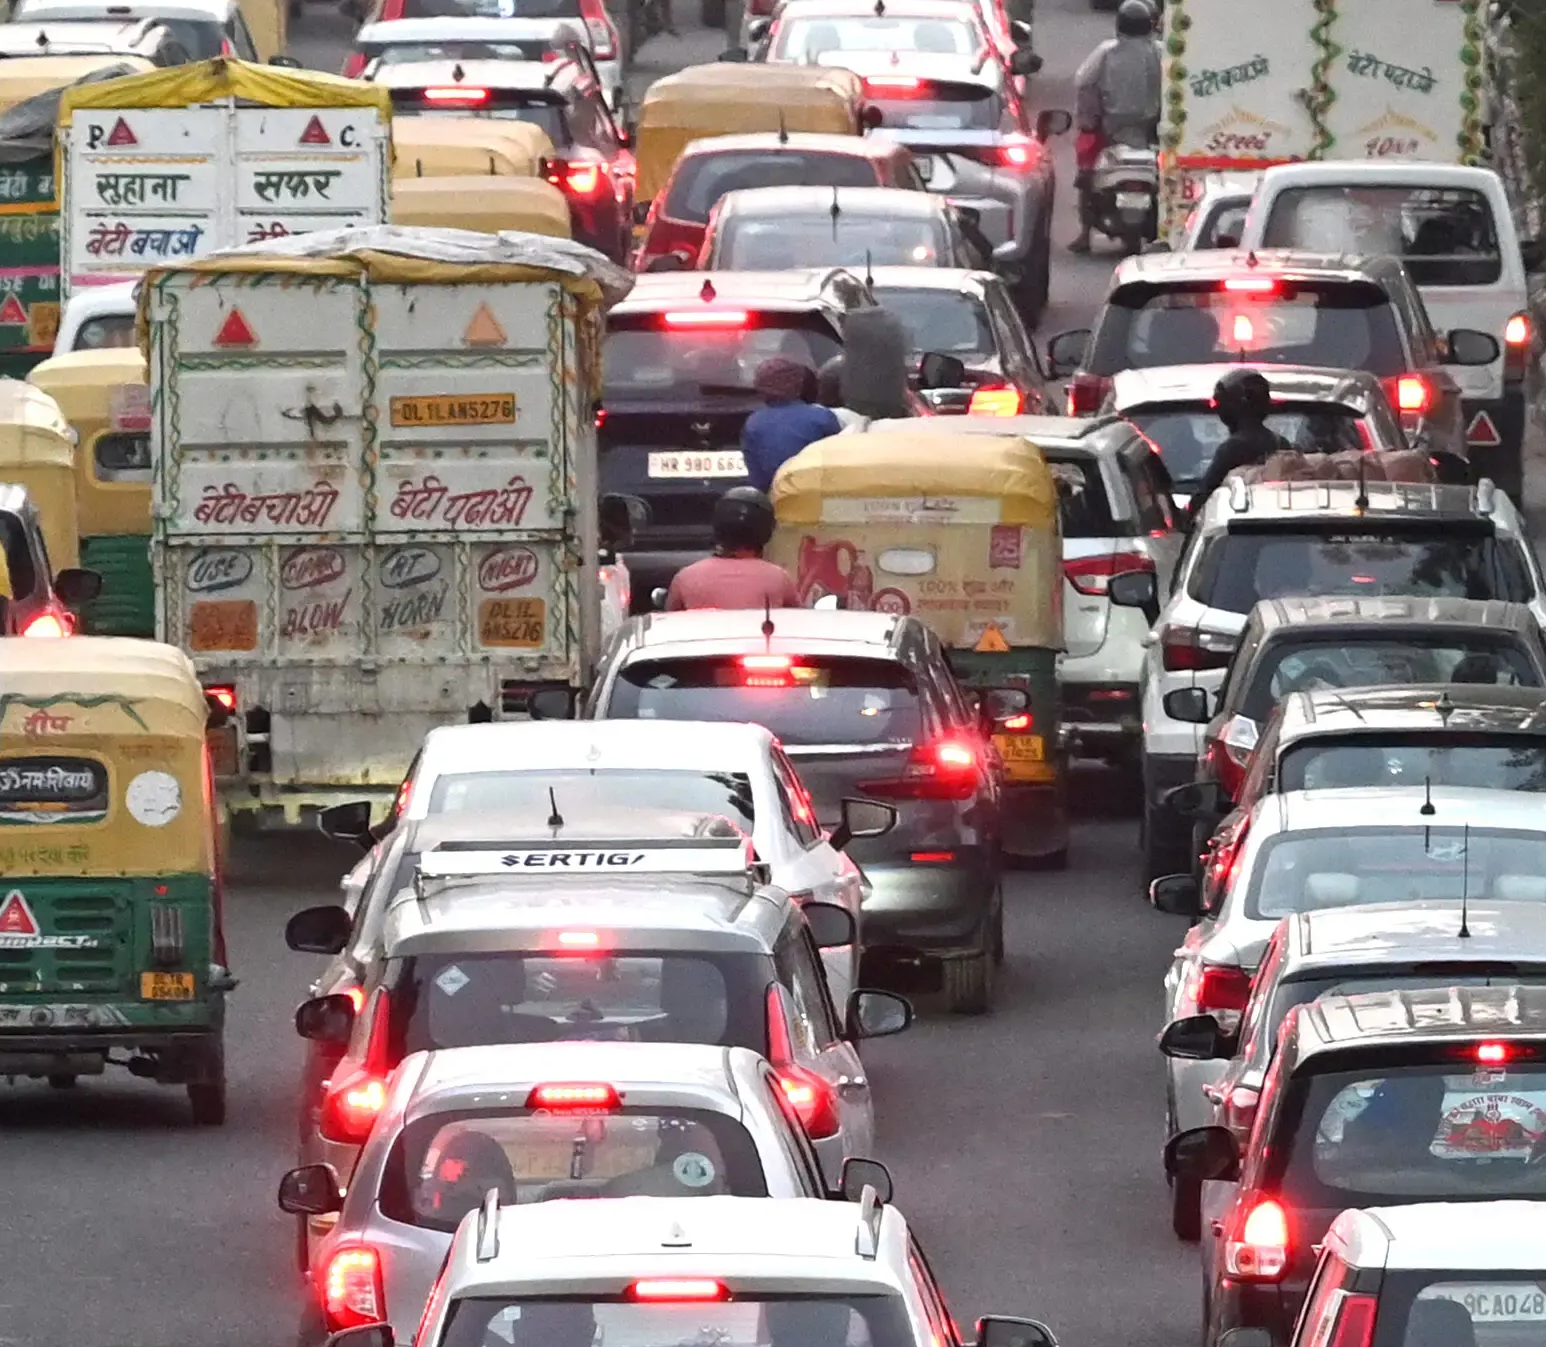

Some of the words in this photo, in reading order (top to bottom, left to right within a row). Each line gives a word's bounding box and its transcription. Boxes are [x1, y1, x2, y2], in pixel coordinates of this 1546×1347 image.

[95, 173, 191, 205] सुहाना
[253, 169, 342, 201] सफर
[86, 222, 133, 258] बेटी
[194, 482, 246, 527] बेटी
[391, 475, 448, 522] बेटी
[194, 552, 237, 583] USE
[482, 553, 534, 585] NIGHT
